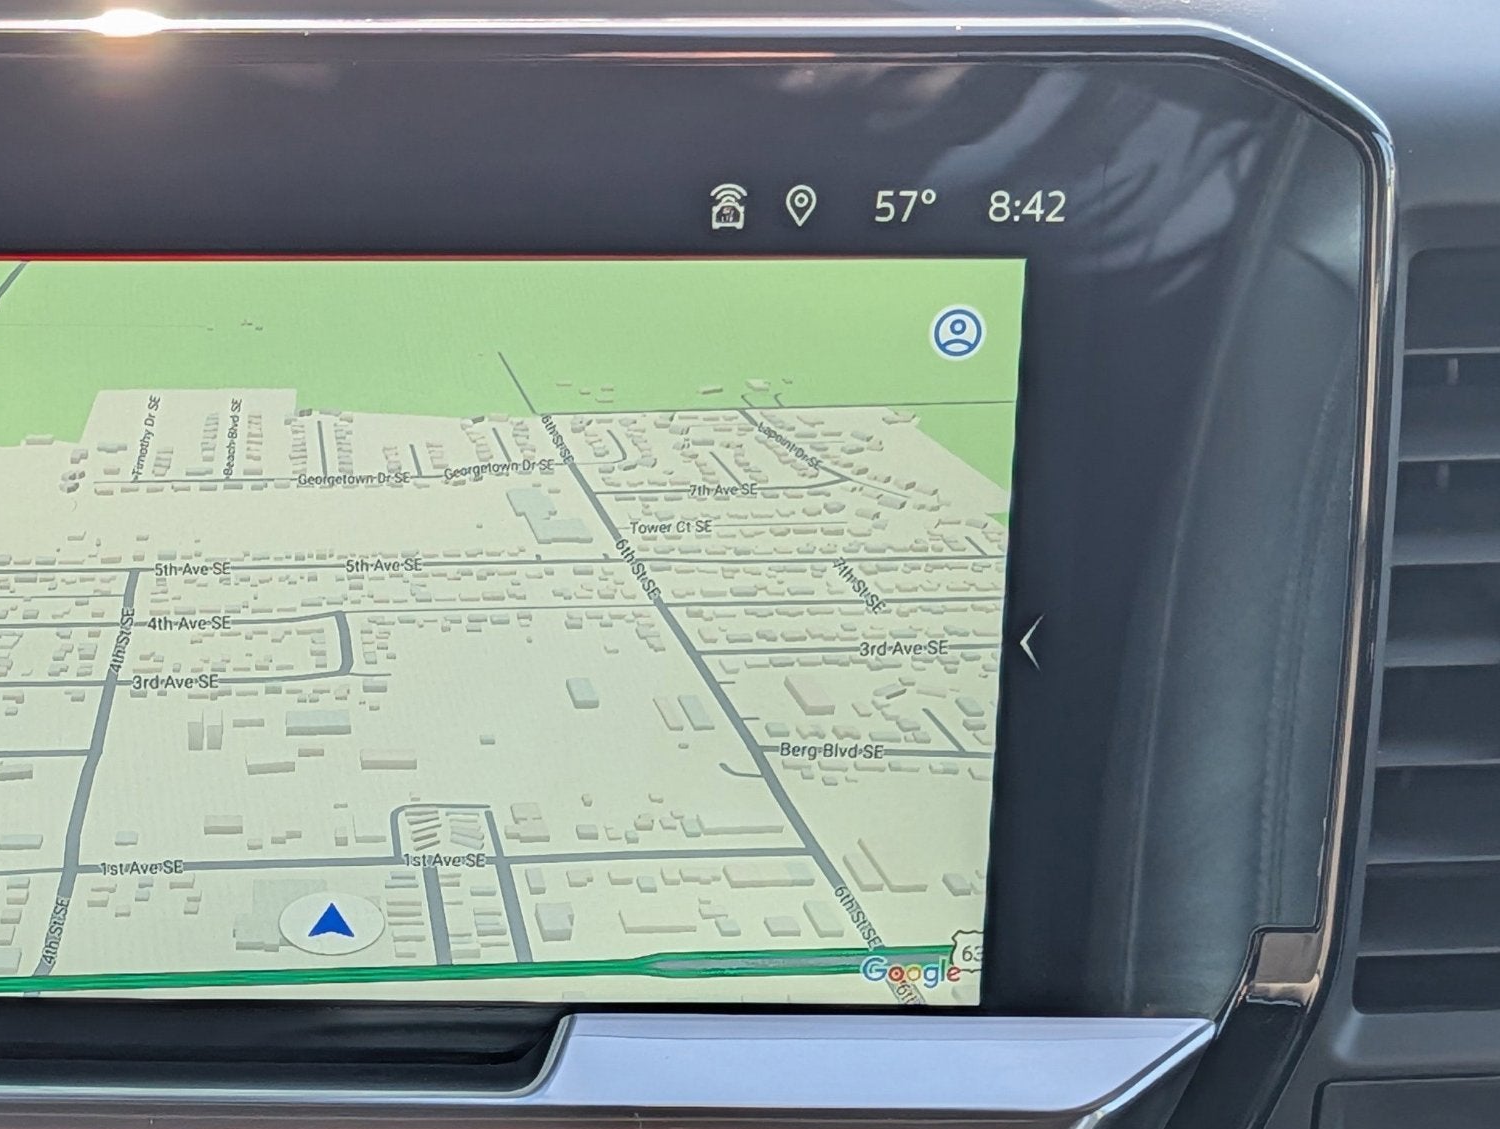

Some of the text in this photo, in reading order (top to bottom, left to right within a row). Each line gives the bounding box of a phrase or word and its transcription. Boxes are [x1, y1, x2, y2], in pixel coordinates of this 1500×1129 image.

[874, 189, 938, 223] 57°
[987, 190, 1067, 223] 8:42
[148, 395, 161, 411] SE
[231, 398, 243, 412] SE
[144, 413, 156, 427] Dr
[443, 459, 555, 481] Georgetown Dr SE
[298, 472, 411, 487] Georgetown Dr SE
[689, 484, 758, 497] 7th Ave SE
[630, 520, 713, 534] Tower Ct SE
[155, 562, 232, 577] 5th Ave SE
[346, 559, 423, 572] 5th Ave SE
[615, 539, 662, 600] 6th St SE
[865, 594, 887, 615] SE
[148, 616, 232, 631] 4th Ave SE
[109, 647, 127, 673] 4th
[121, 607, 136, 626] SE
[859, 640, 949, 656] 3rd Ave SE
[132, 674, 219, 690] 3rd Ave SE
[780, 743, 885, 760] Berg Blvd SE
[101, 860, 184, 876] 1st Ave SE
[404, 853, 486, 867] 1st Ave SE
[53, 899, 70, 919] SE
[835, 886, 855, 911] 6th
[862, 926, 883, 949] SE
[862, 956, 962, 989] Google
